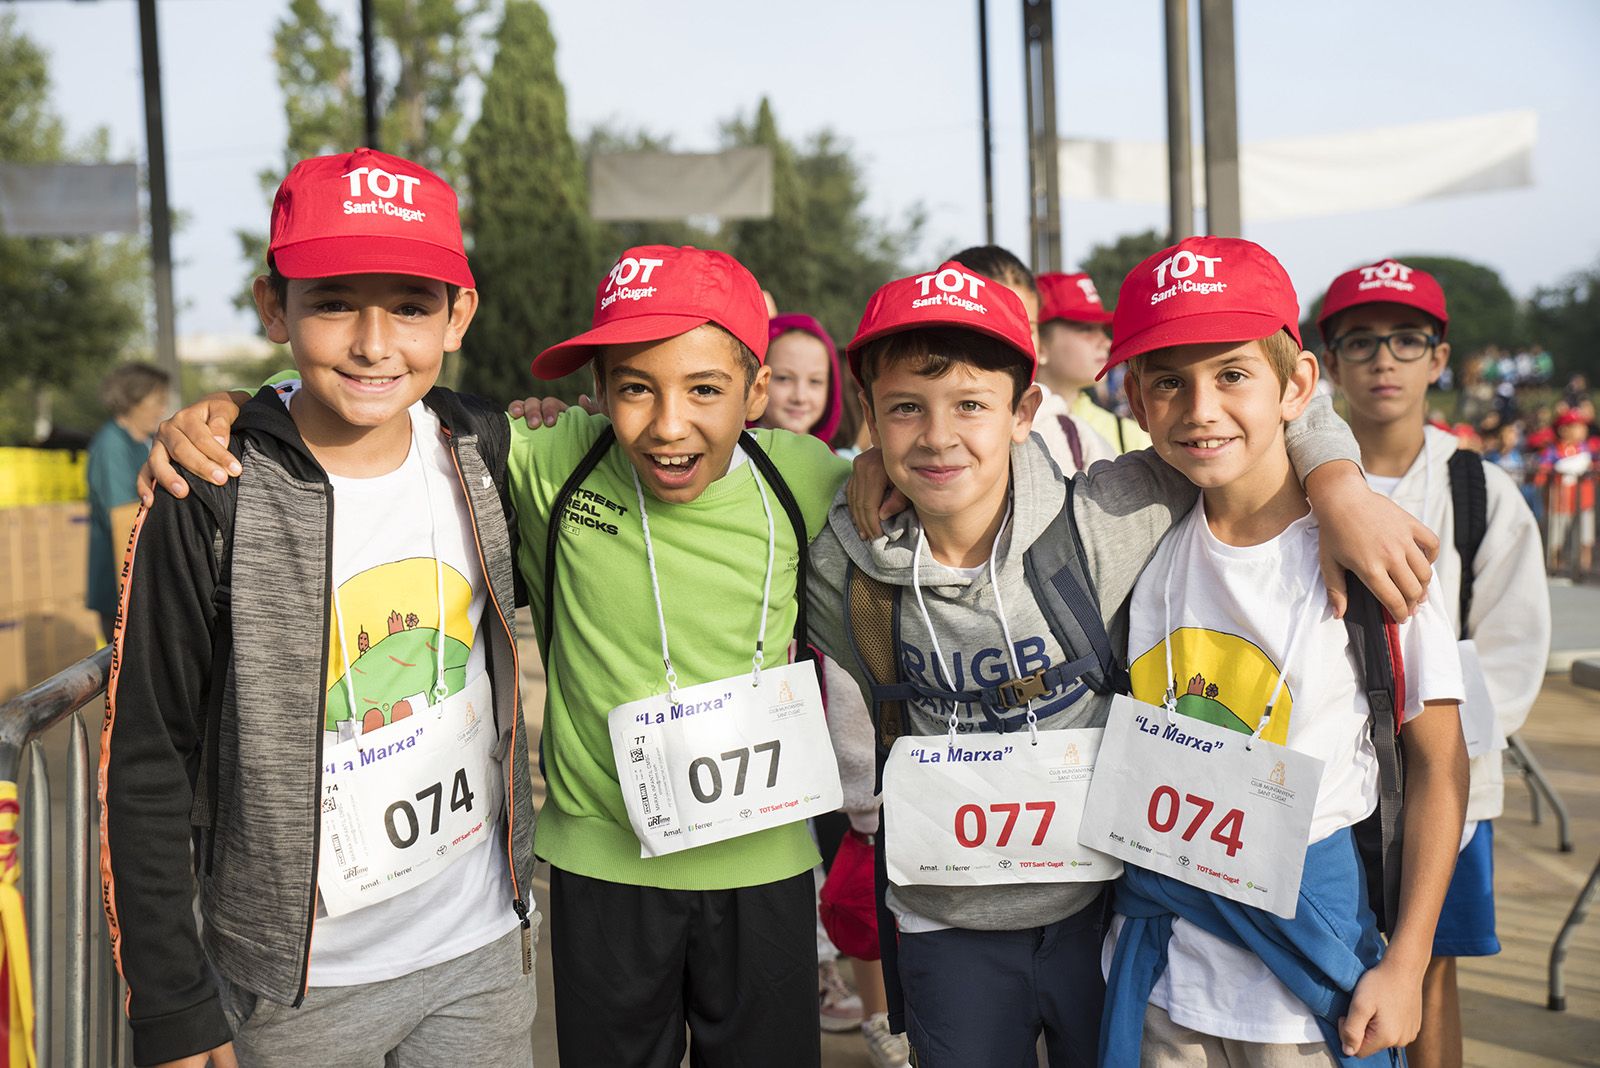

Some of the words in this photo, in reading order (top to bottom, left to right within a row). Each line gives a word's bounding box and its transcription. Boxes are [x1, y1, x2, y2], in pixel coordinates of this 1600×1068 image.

[341, 167, 420, 204] TOT
[343, 200, 378, 214] Sant
[384, 202, 426, 222] Cugat
[605, 257, 664, 293] TOT
[1152, 250, 1222, 288] TOT
[1360, 262, 1414, 281] TOT
[621, 286, 657, 300] Cugat
[914, 268, 986, 300] TOT
[1151, 285, 1177, 305] Sant
[1183, 280, 1227, 294] Cugat
[912, 294, 943, 309] Sant
[948, 294, 988, 314] Cugat
[574, 486, 628, 516] TREET
[562, 508, 619, 536] TRICKS
[902, 636, 1051, 692] RUGB
[670, 692, 732, 721] Marxa”
[919, 696, 981, 719] ANT
[360, 727, 424, 768] Marxa”
[634, 735, 646, 745] 77
[1135, 715, 1160, 736] “La
[1161, 724, 1224, 753] Marxa”
[910, 749, 941, 763] “La
[946, 746, 1014, 763] Marxa”
[688, 740, 781, 804] 077
[325, 783, 339, 795] 74
[384, 768, 475, 849] 074
[1147, 785, 1245, 858] 074
[694, 821, 713, 830] ferrer
[954, 801, 1056, 849] 077
[393, 866, 413, 879] ferrer
[952, 864, 970, 872] ferrer
[1047, 861, 1065, 869] Cugat
[1135, 841, 1152, 853] ferrer
[1222, 873, 1240, 885] Cugat
